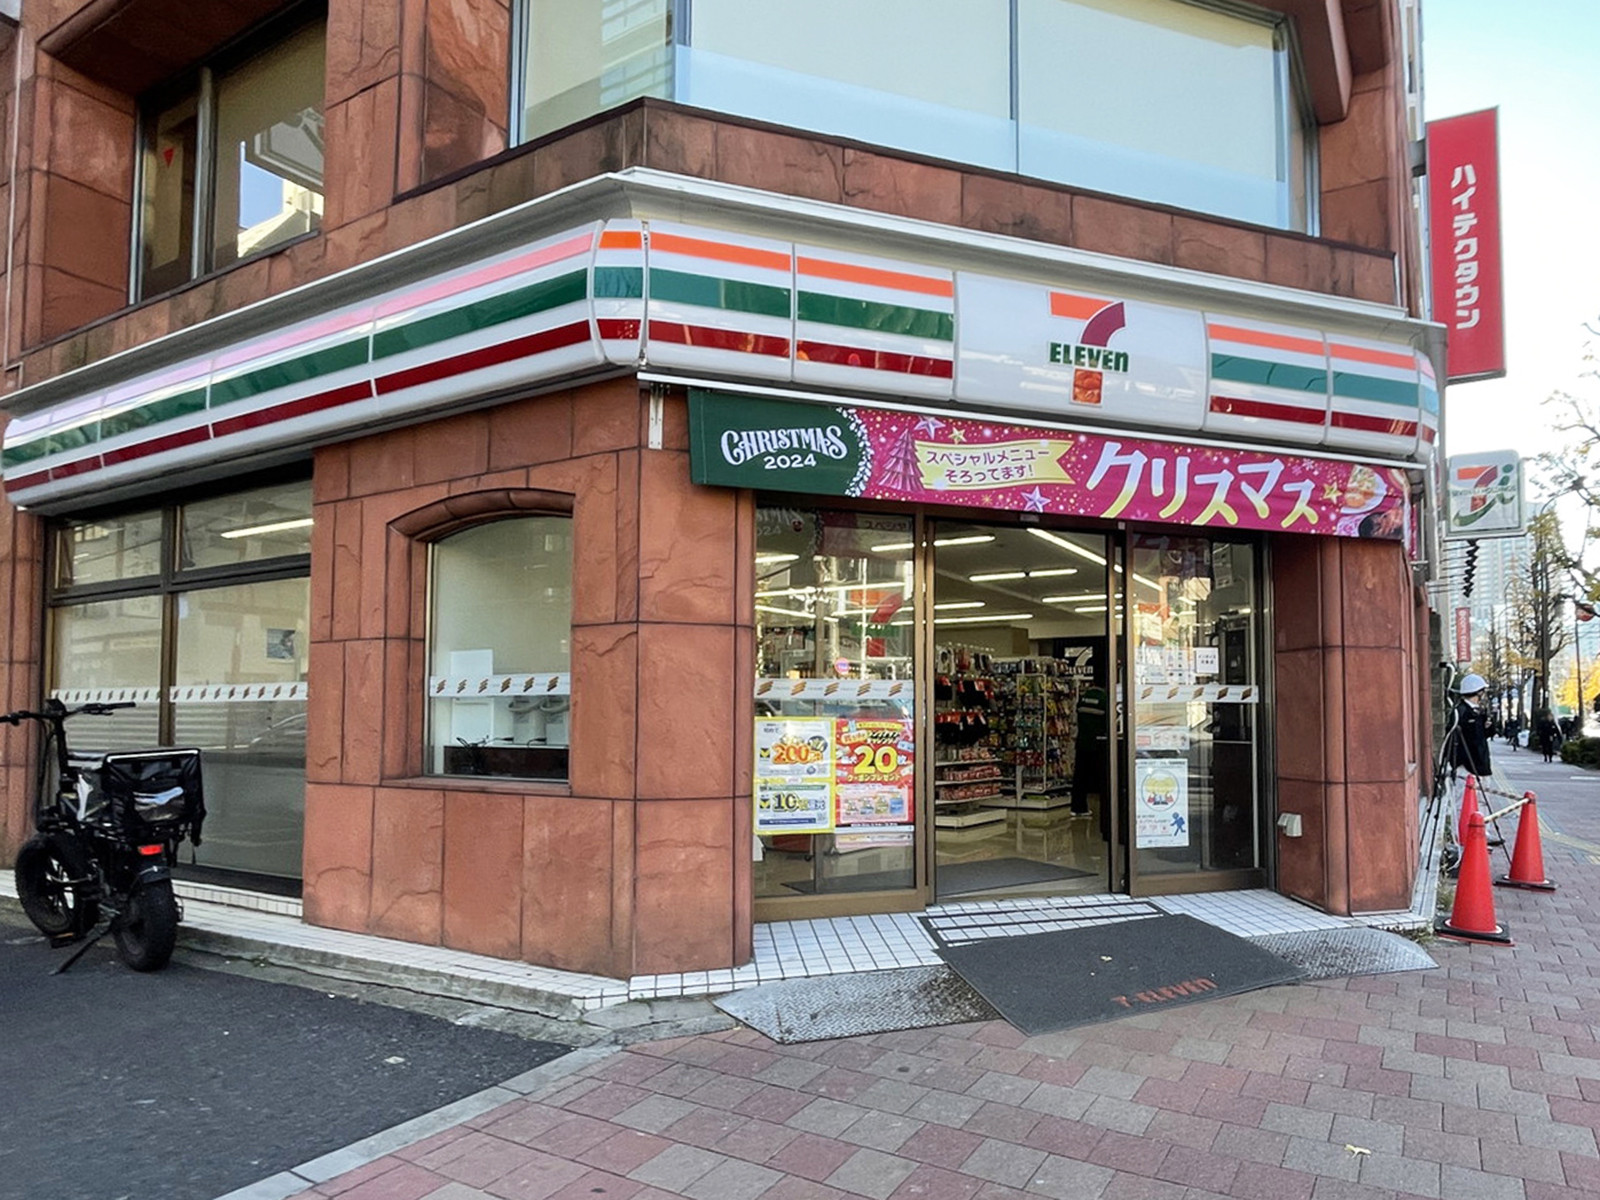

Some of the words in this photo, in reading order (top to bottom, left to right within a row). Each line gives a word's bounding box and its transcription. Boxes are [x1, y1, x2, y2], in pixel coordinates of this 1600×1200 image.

[1451, 164, 1480, 330] ハイテクタウン
[721, 425, 848, 465] CHRISTMAS
[763, 453, 817, 469] 2024
[926, 448, 1050, 467] スペシャルメニュー
[1086, 441, 1319, 528] クリスマス
